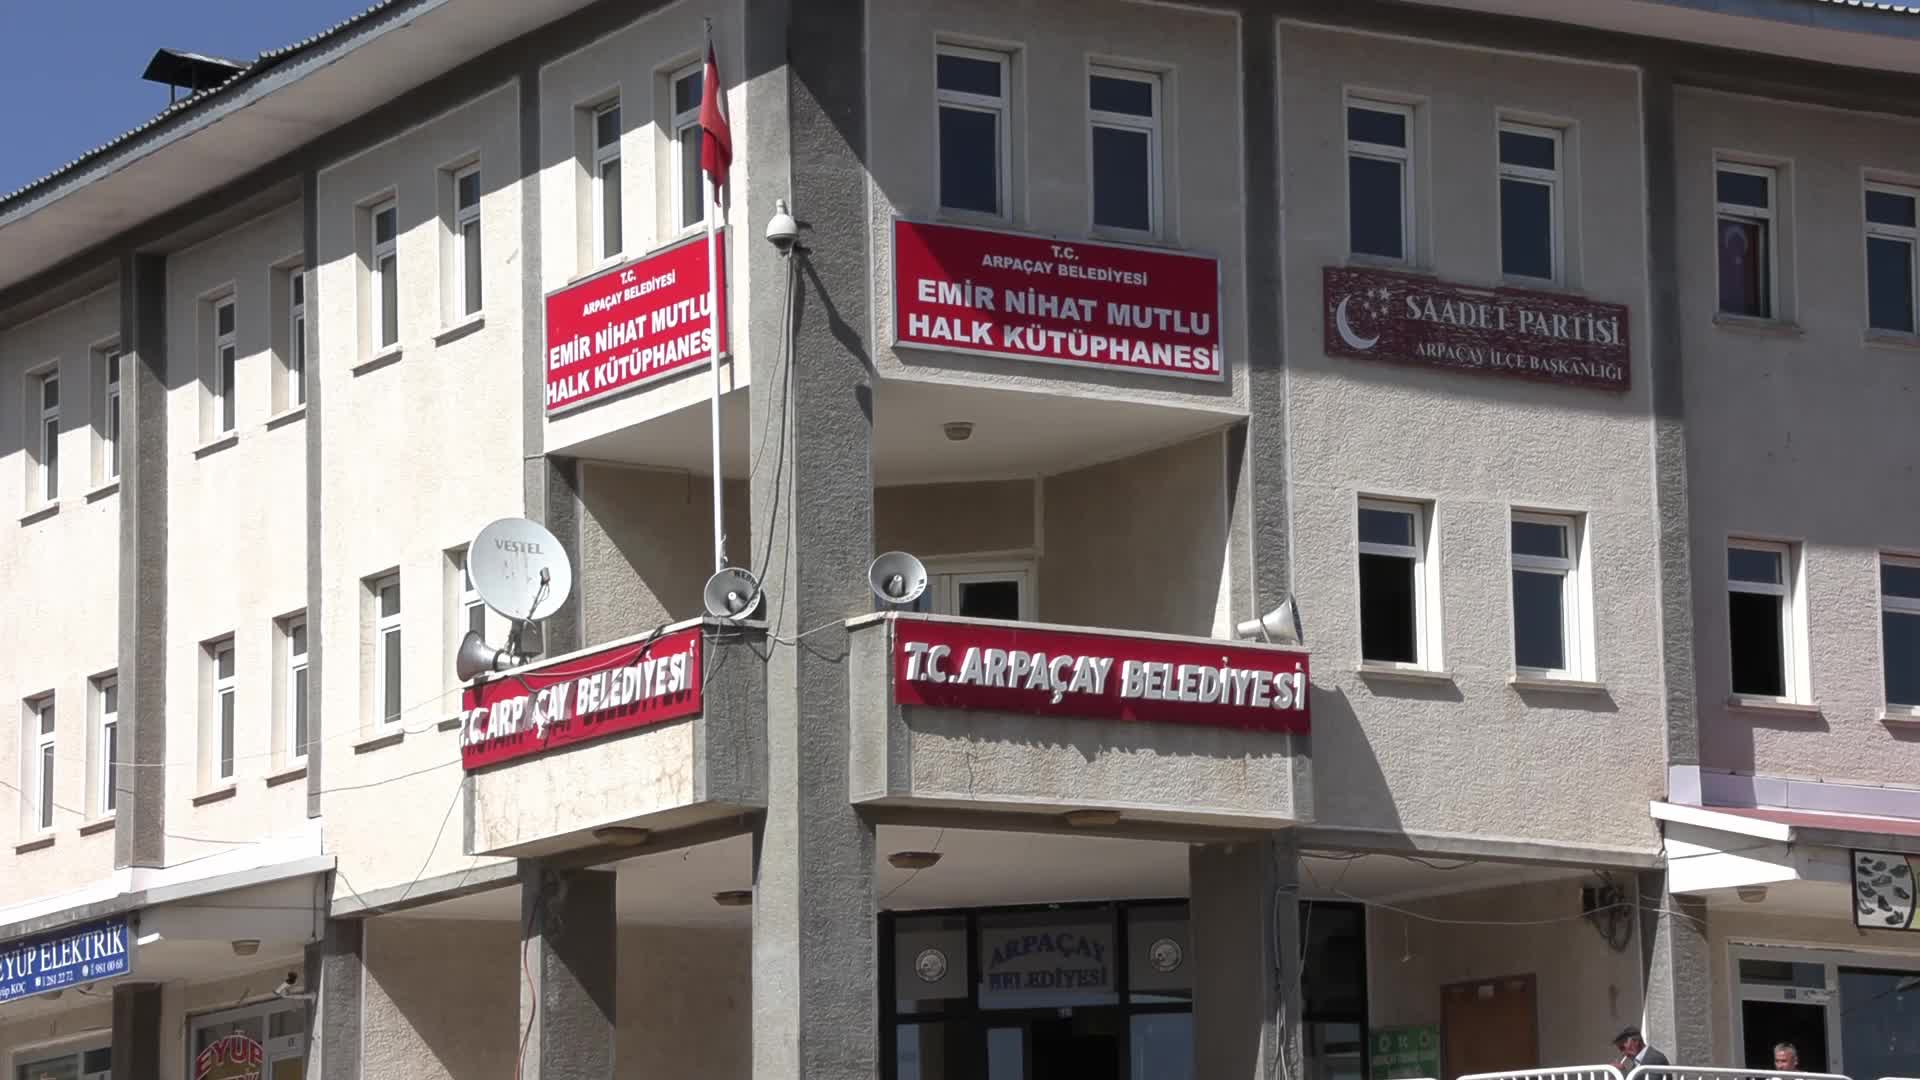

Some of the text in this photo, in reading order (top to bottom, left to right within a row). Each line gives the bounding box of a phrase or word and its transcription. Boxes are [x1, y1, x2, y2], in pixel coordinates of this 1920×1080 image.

[620, 269, 637, 285] T.C.
[981, 253, 1148, 287] ARPAÇAY BELEDİYESİ
[1051, 245, 1079, 261] T.C.
[582, 269, 677, 317] ARPAÇAY BELEDİYESİ
[917, 278, 1210, 336] EMİR NİHAT MUTLU
[550, 291, 713, 370] EMİR NİHAT MUTLU
[908, 312, 1220, 371] HALK KÜTÜPHANESİ
[1405, 294, 1620, 346] SAADET PARTİSİ
[546, 328, 714, 405] HALK KÜTÜPHANES
[1415, 342, 1484, 365] ARPAÇAY
[494, 538, 545, 555] VESTEL
[1120, 655, 1306, 711] BELEDİYESİ
[39, 920, 125, 972] ELEKTRİK
